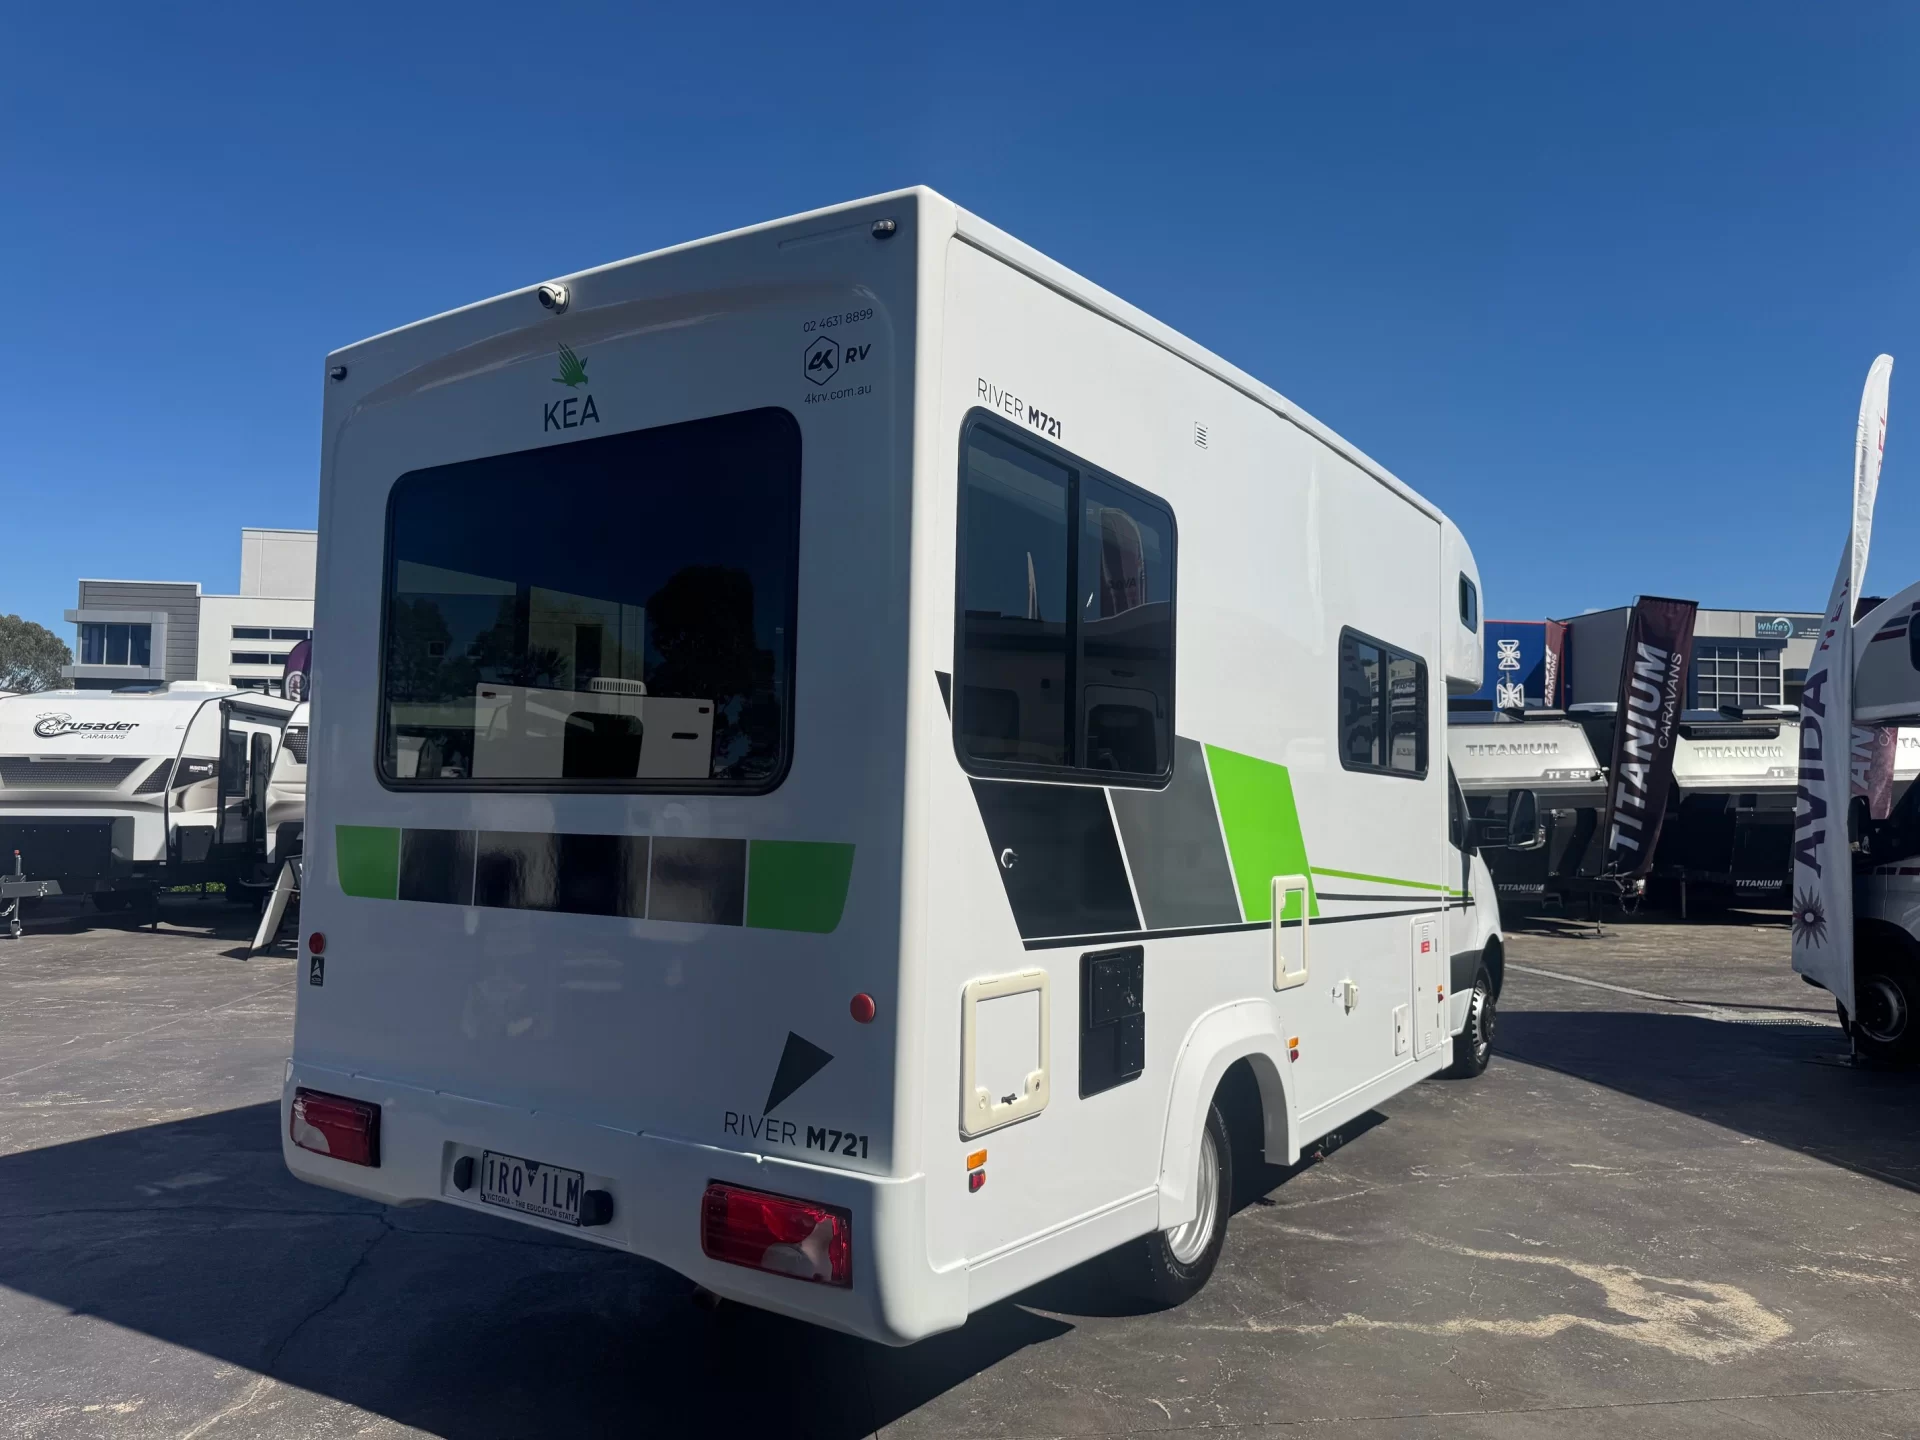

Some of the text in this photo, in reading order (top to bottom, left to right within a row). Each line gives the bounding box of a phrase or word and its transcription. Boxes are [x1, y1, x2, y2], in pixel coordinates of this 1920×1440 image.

[803, 308, 874, 333] 02 4631 8899
[844, 343, 872, 364] RV
[804, 384, 872, 404] 4krv.com.au
[543, 394, 600, 432] KEA
[977, 377, 1062, 440] RIVER M721
[1757, 622, 1788, 632] White's
[1657, 652, 1683, 749] CARAVANS
[1465, 743, 1559, 757] TITANIUM
[1609, 641, 1668, 852] TITANIUM
[1693, 746, 1784, 758] TITANIUM
[1795, 668, 1828, 880] AVIDA
[1498, 883, 1545, 891] TITANIUM
[1736, 879, 1783, 887] TITANIUM
[724, 1111, 869, 1159] RIVER M721
[489, 1160, 580, 1212] 1RQ 1LM
[487, 1193, 511, 1205] VICTORIA
[515, 1200, 526, 1209] THE
[527, 1202, 557, 1217] EDUCATION
[558, 1211, 576, 1221] STATE
